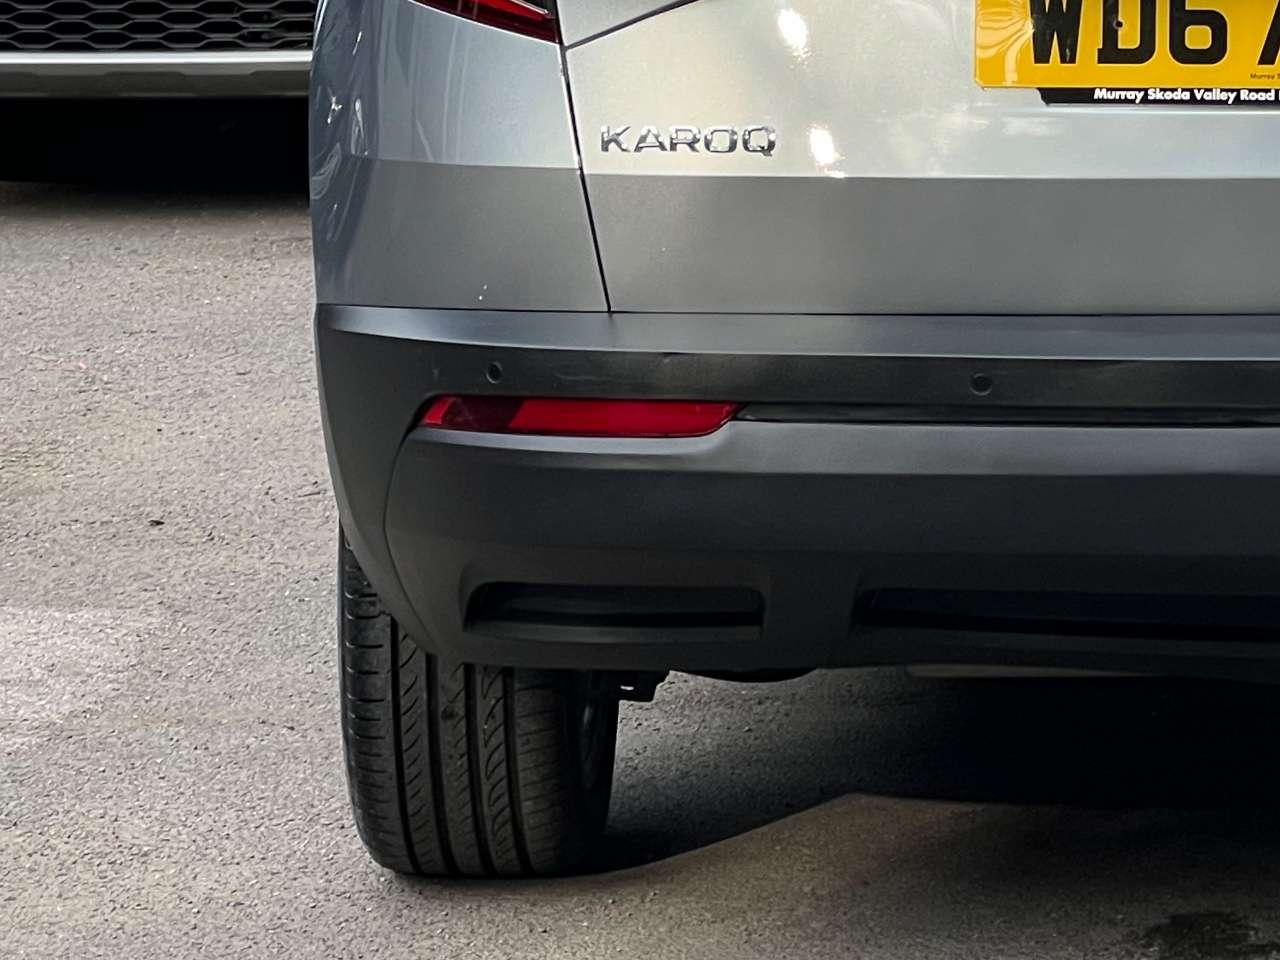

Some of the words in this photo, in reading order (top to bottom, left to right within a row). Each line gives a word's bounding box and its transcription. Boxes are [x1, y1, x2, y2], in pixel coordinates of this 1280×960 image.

[1094, 88, 1144, 104] Murray
[1147, 88, 1191, 101] Skoda
[1194, 89, 1237, 105] Valley
[1240, 89, 1275, 102] Road
[600, 125, 777, 157] KAROQ
